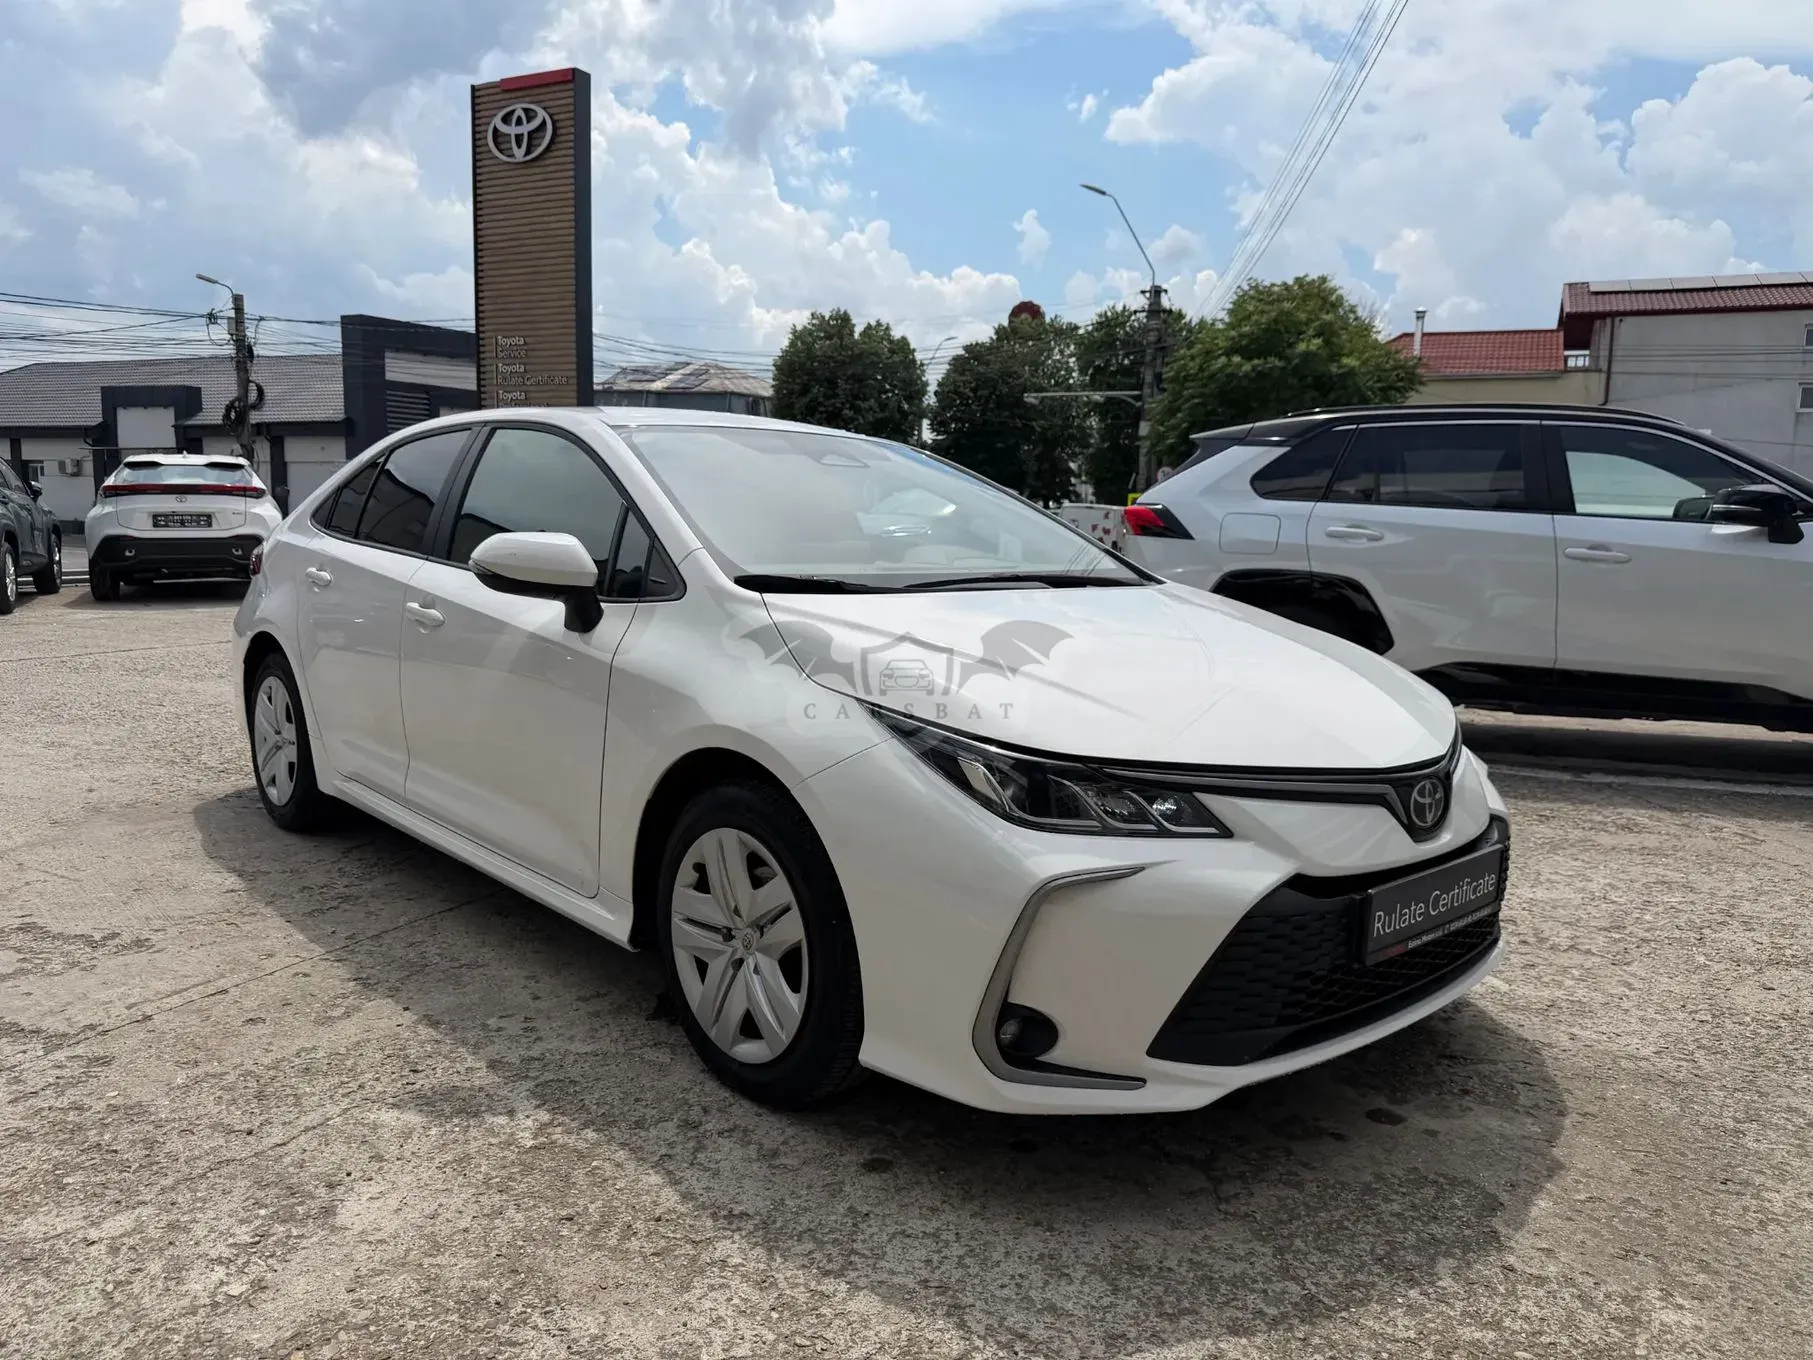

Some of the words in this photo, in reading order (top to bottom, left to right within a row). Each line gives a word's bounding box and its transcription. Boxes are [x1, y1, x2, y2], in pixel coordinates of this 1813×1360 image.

[497, 336, 525, 347] Toyota
[498, 348, 526, 358] Service
[498, 363, 525, 374] Toyota
[498, 375, 524, 385] Rulate
[525, 374, 568, 385] Certificate
[499, 390, 526, 402] Toyota
[1373, 901, 1425, 938] Rulate
[1429, 872, 1496, 916] Certificate
